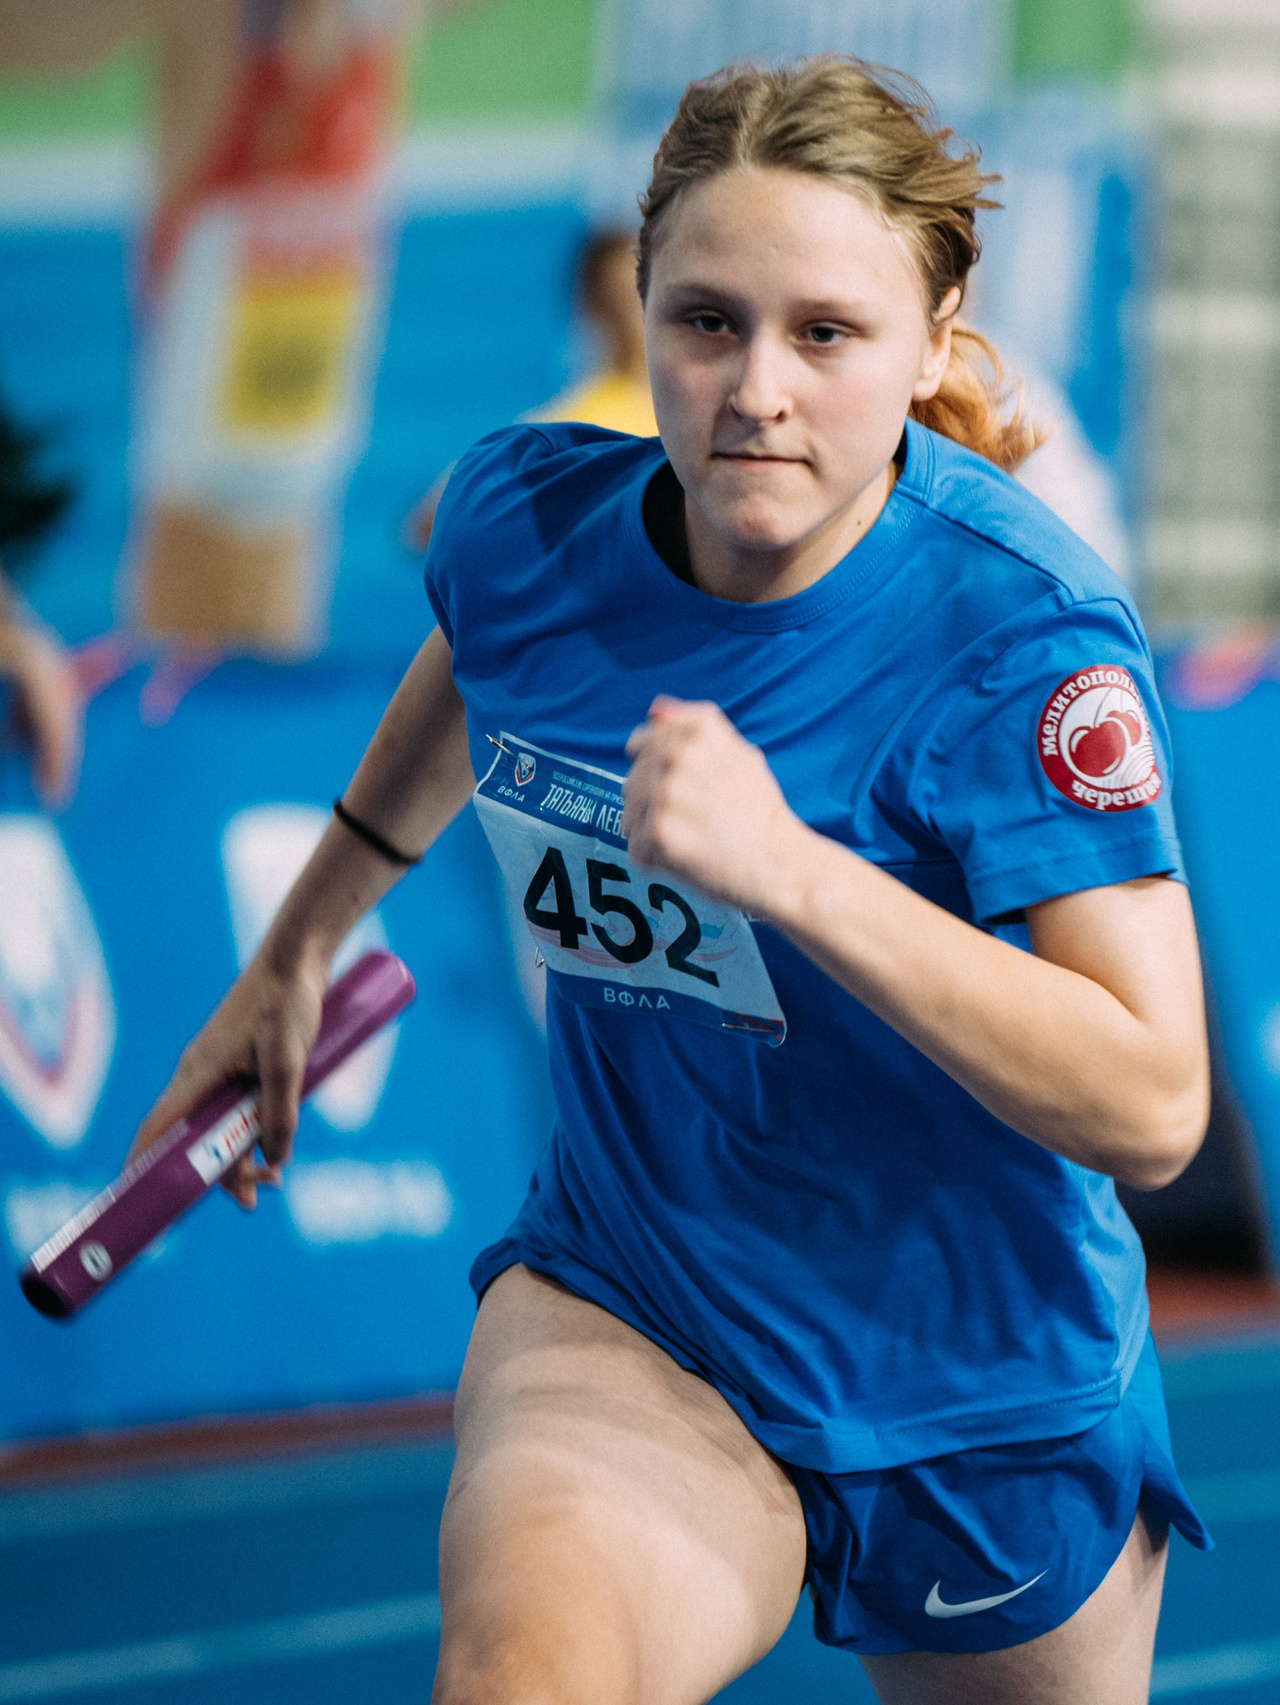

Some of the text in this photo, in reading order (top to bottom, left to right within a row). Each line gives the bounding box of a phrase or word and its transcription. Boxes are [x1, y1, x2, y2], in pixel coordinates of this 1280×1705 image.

[1041, 670, 1145, 757] мелитополь
[497, 785, 526, 803] ВФЛА
[541, 784, 598, 824] ТАТЬЯНЫ
[523, 846, 720, 988] 452
[603, 987, 671, 1010] ВФЛА
